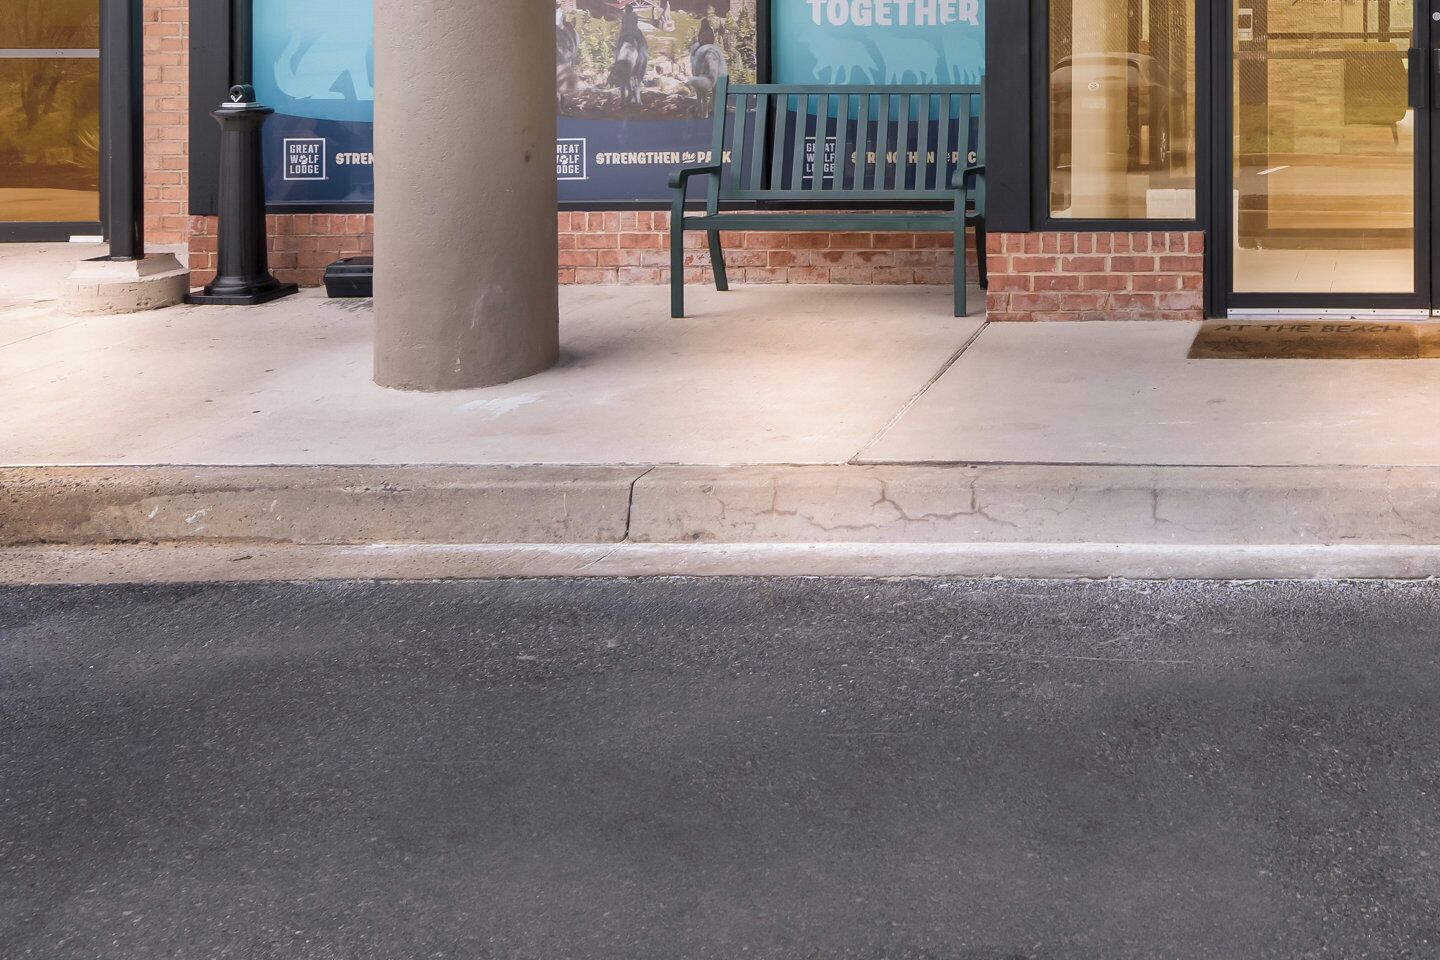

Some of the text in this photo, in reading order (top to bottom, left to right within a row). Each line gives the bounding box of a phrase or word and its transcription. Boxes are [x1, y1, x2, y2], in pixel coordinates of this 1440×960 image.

[289, 144, 320, 154] GREAT
[556, 144, 580, 154] REAT
[556, 154, 580, 164] OLF
[595, 151, 732, 165] STRENGTHEN the PAK
[289, 164, 320, 174] LODGE
[556, 164, 580, 174] ODGE
[1215, 324, 1402, 332] AT THE BEACH
